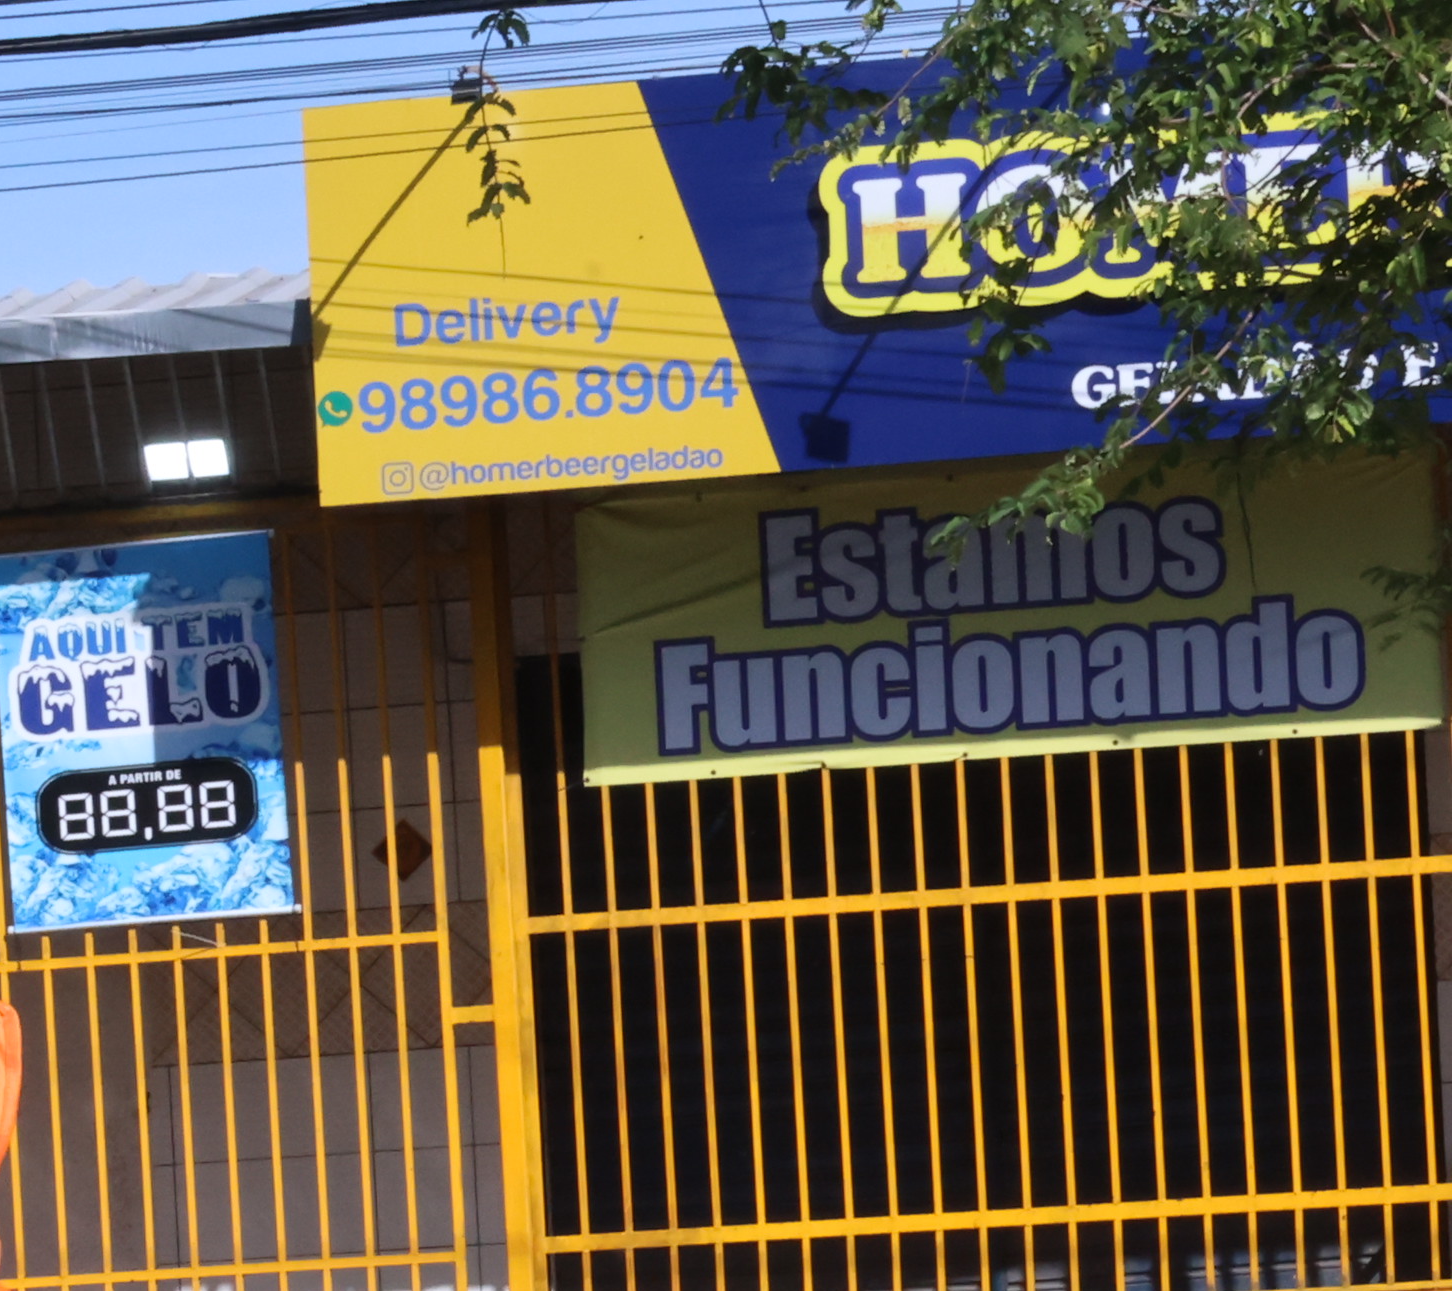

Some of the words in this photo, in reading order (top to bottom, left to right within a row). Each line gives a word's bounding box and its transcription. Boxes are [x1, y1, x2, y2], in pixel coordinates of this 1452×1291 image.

[393, 296, 620, 347] Delivery
[358, 356, 739, 434] 98986.8904
[419, 445, 724, 491] @homerbeergeladao
[758, 495, 1226, 628] Estamos
[28, 617, 128, 662] AQUI
[142, 607, 245, 651] TEM
[17, 645, 263, 736] GELO
[654, 594, 1366, 758] Funcionando
[108, 775, 118, 786] A
[120, 771, 163, 786] PARTIR
[166, 768, 183, 782] DE
[57, 779, 238, 842] 88,88
